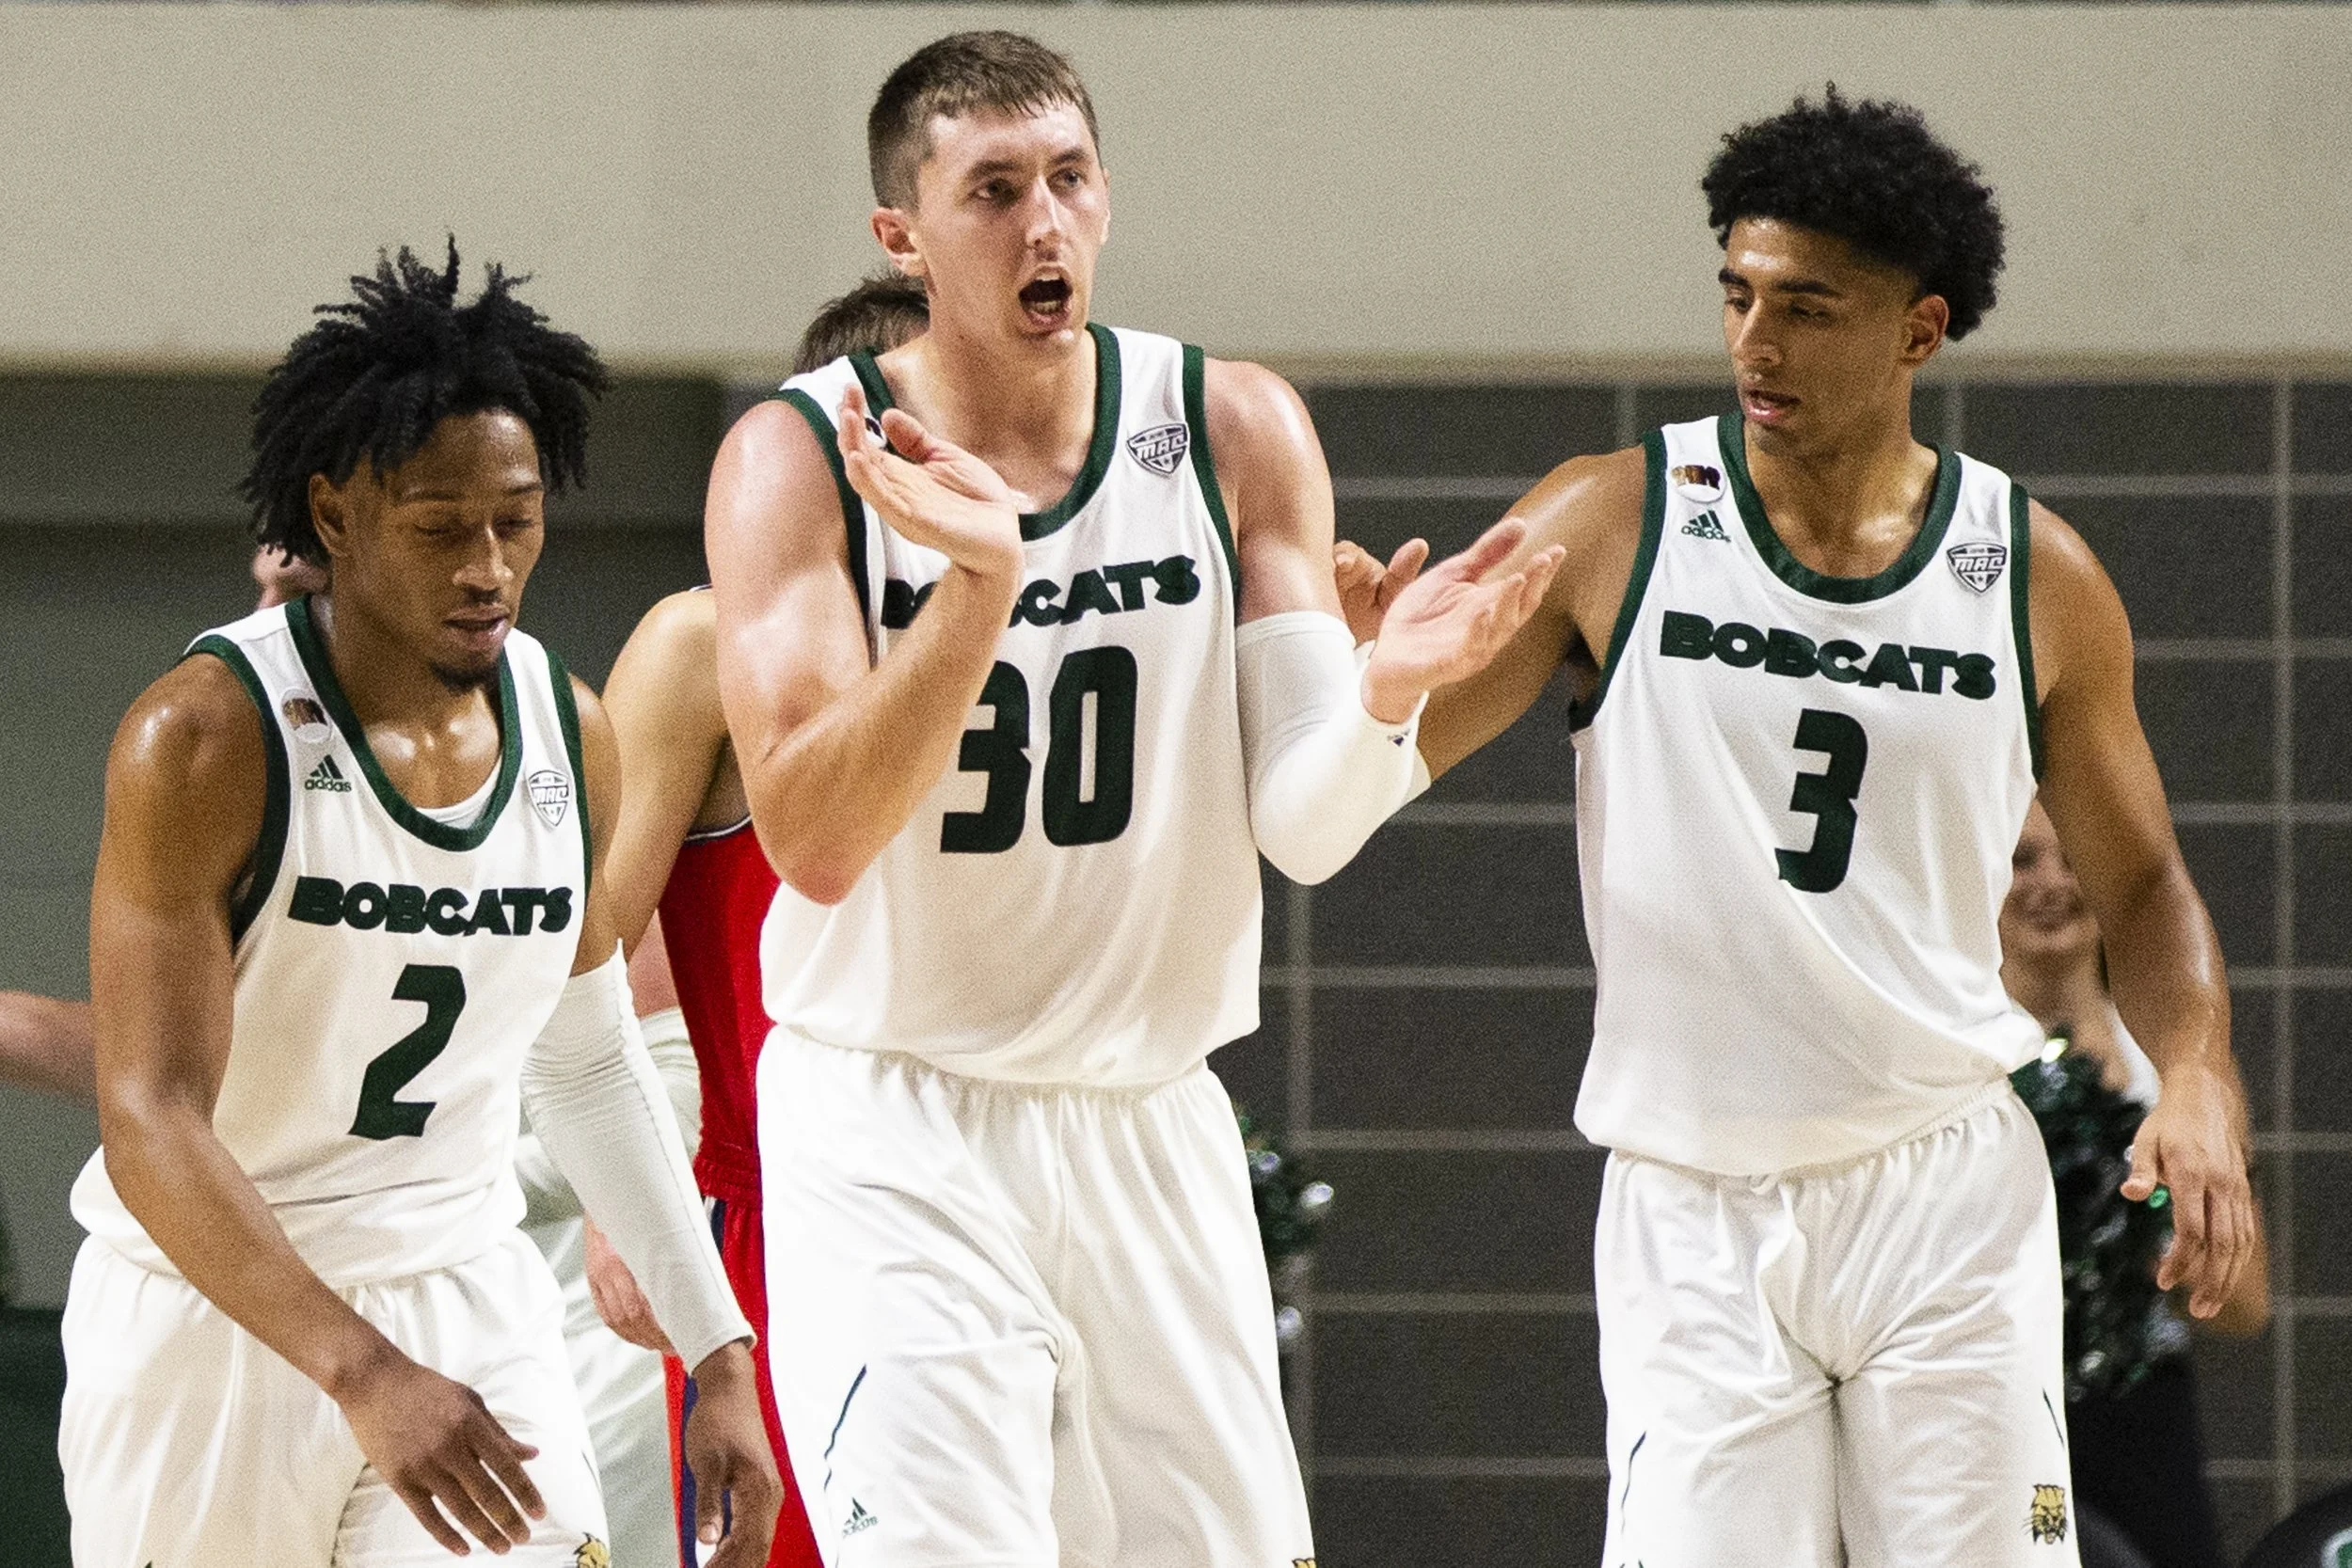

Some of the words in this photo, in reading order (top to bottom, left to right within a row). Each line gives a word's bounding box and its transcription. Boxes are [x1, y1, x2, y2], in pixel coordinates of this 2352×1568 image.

[1681, 525, 1731, 543] adidas
[1955, 556, 2005, 573] MAC
[881, 554, 1201, 629] BCATS
[1660, 610, 1996, 700] BOBCATS
[304, 778, 352, 792] adidas
[940, 645, 1137, 853] 30
[1774, 708, 1868, 894] 3
[288, 876, 573, 937] BOBCATS
[347, 962, 467, 1141] 2
